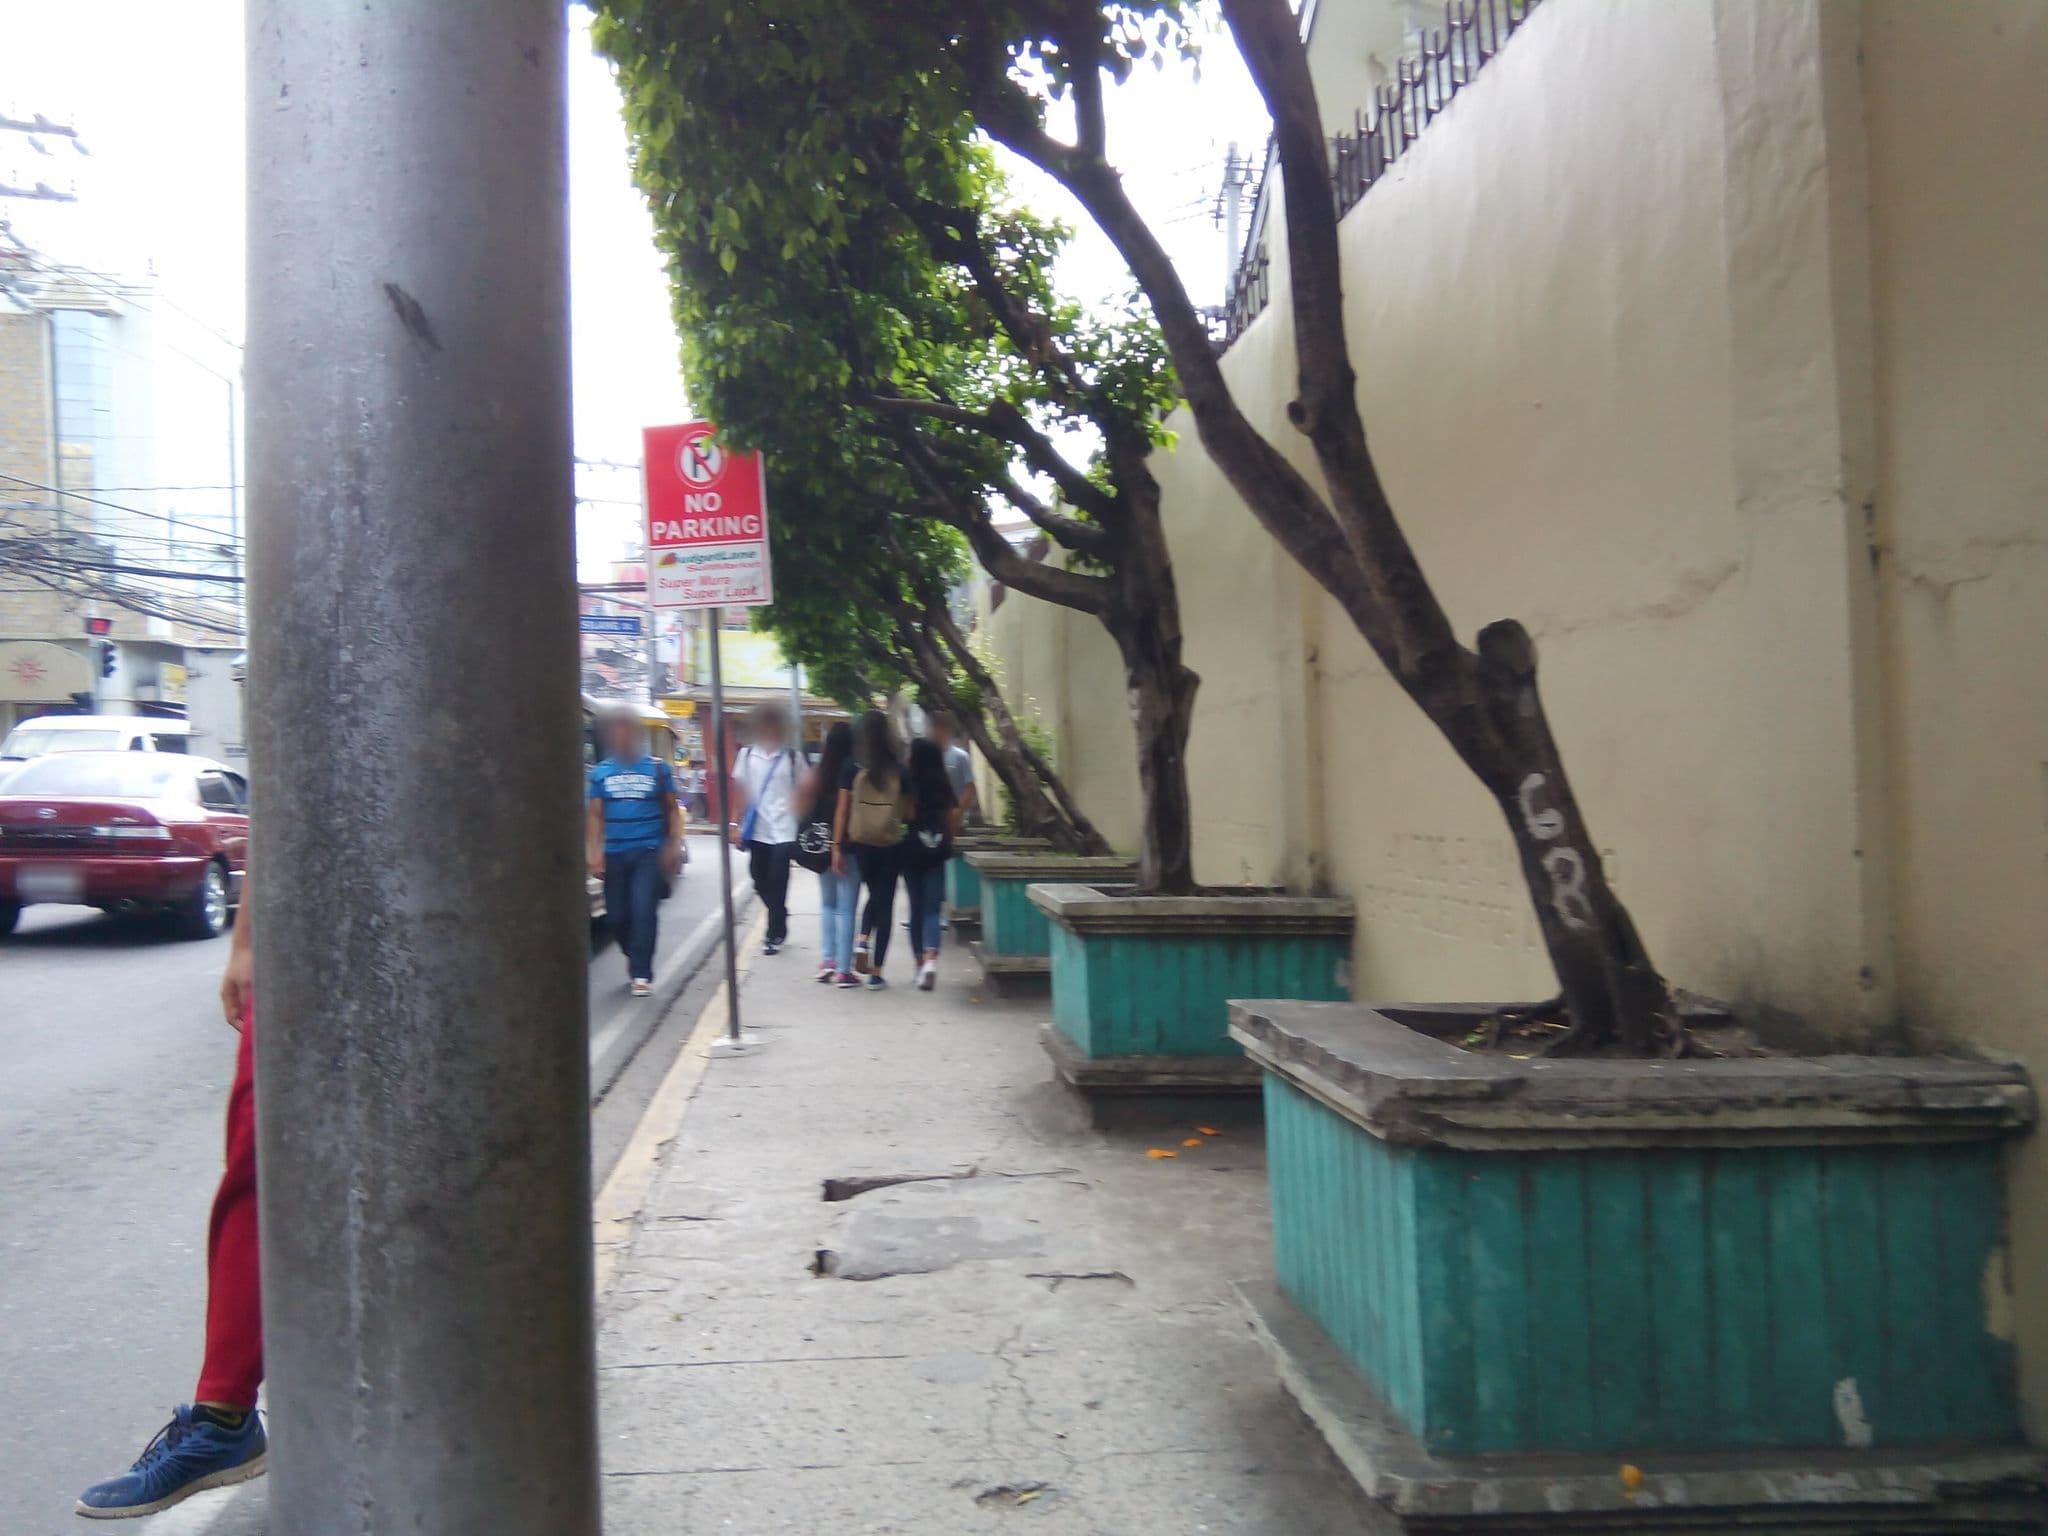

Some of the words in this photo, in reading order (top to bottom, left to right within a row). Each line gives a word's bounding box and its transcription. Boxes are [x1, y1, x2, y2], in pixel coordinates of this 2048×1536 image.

[685, 492, 721, 513] NO
[652, 514, 760, 541] PARKING
[659, 577, 695, 590] Super
[683, 588, 719, 600] Super
